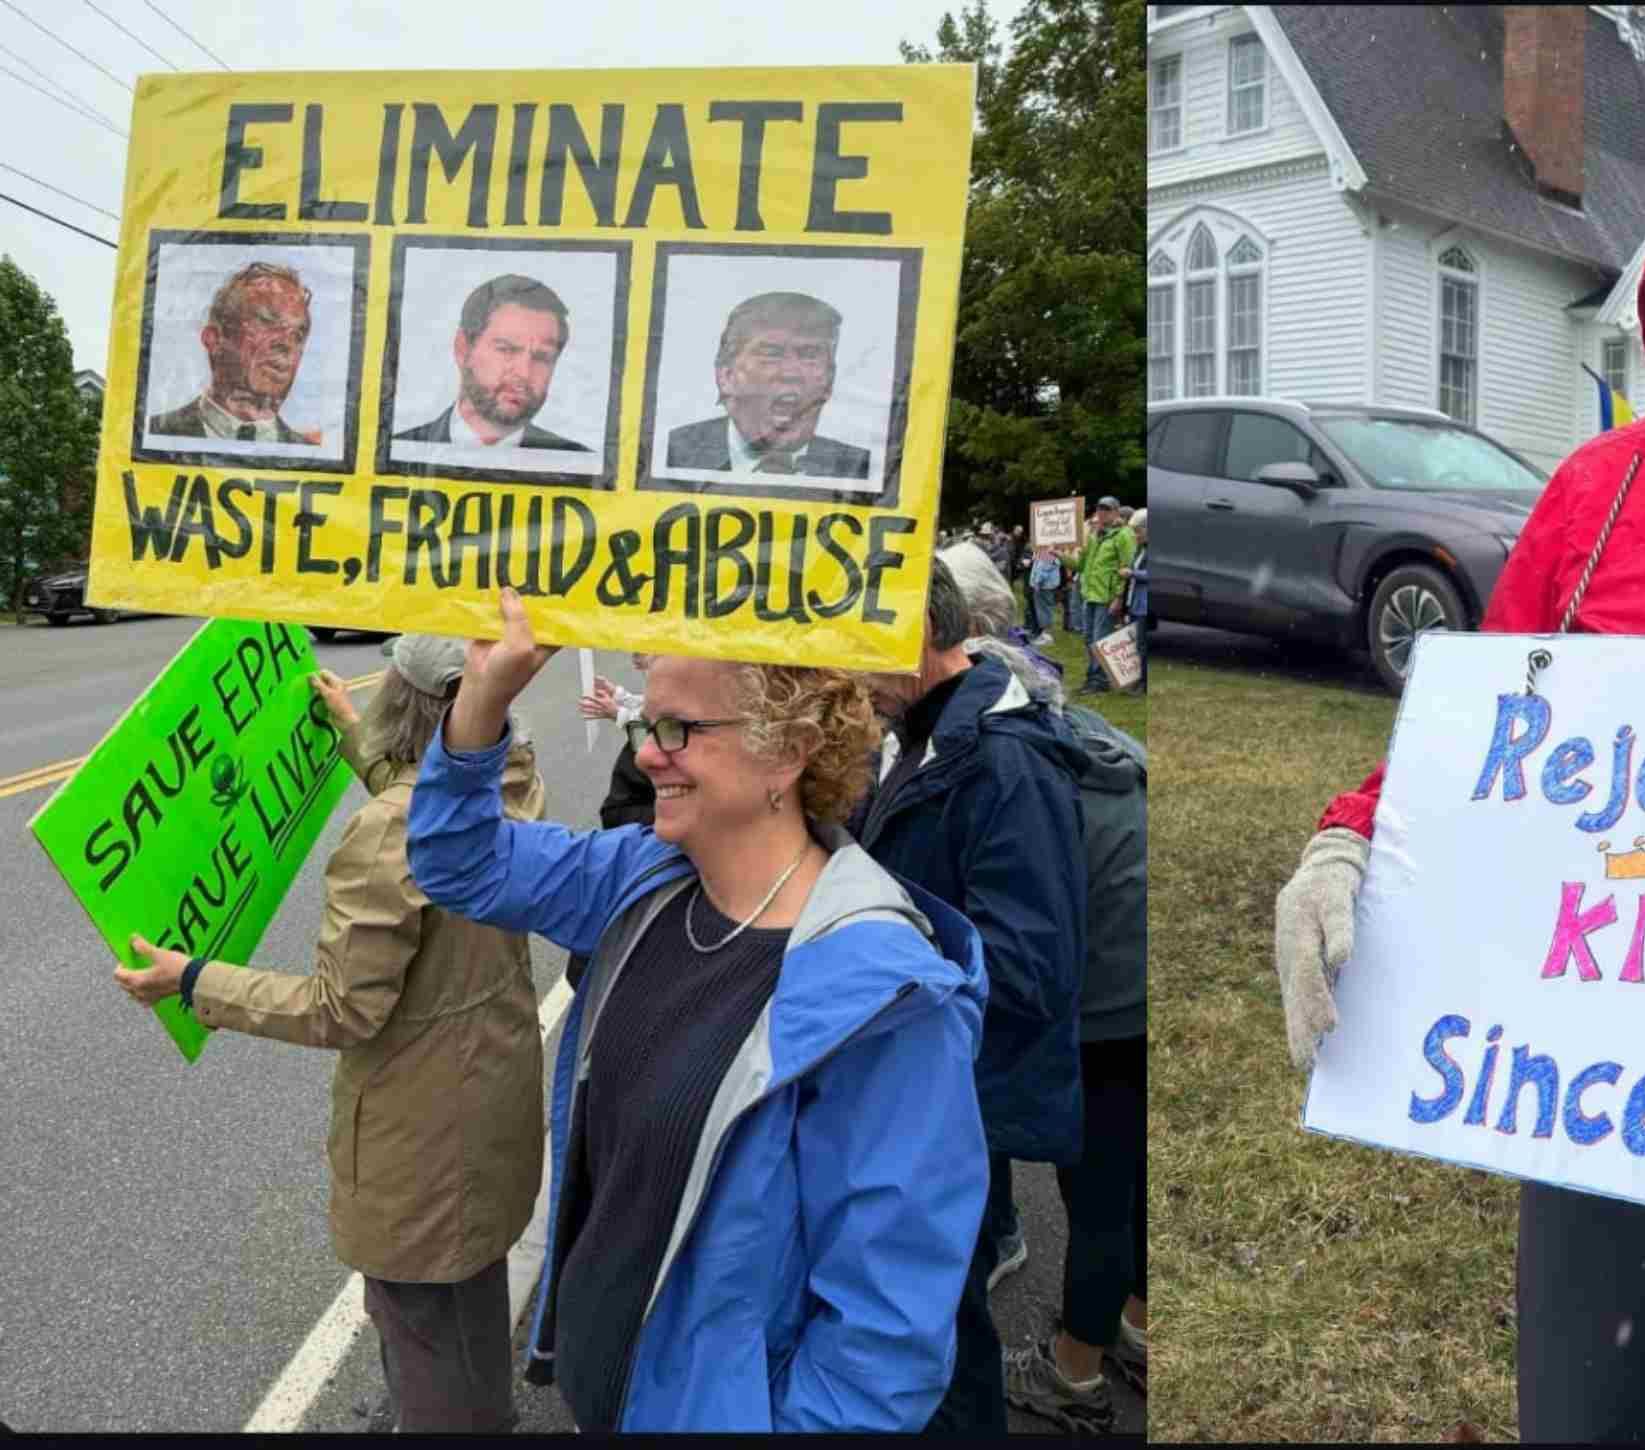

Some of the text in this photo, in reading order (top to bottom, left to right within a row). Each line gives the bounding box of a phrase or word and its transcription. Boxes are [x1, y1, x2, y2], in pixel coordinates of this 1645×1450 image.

[218, 101, 904, 235] ELIMINATE
[122, 470, 918, 625] WASTE, FRAUD & ABUSE
[85, 704, 215, 893] SAVE
[250, 693, 338, 845] LIVES
